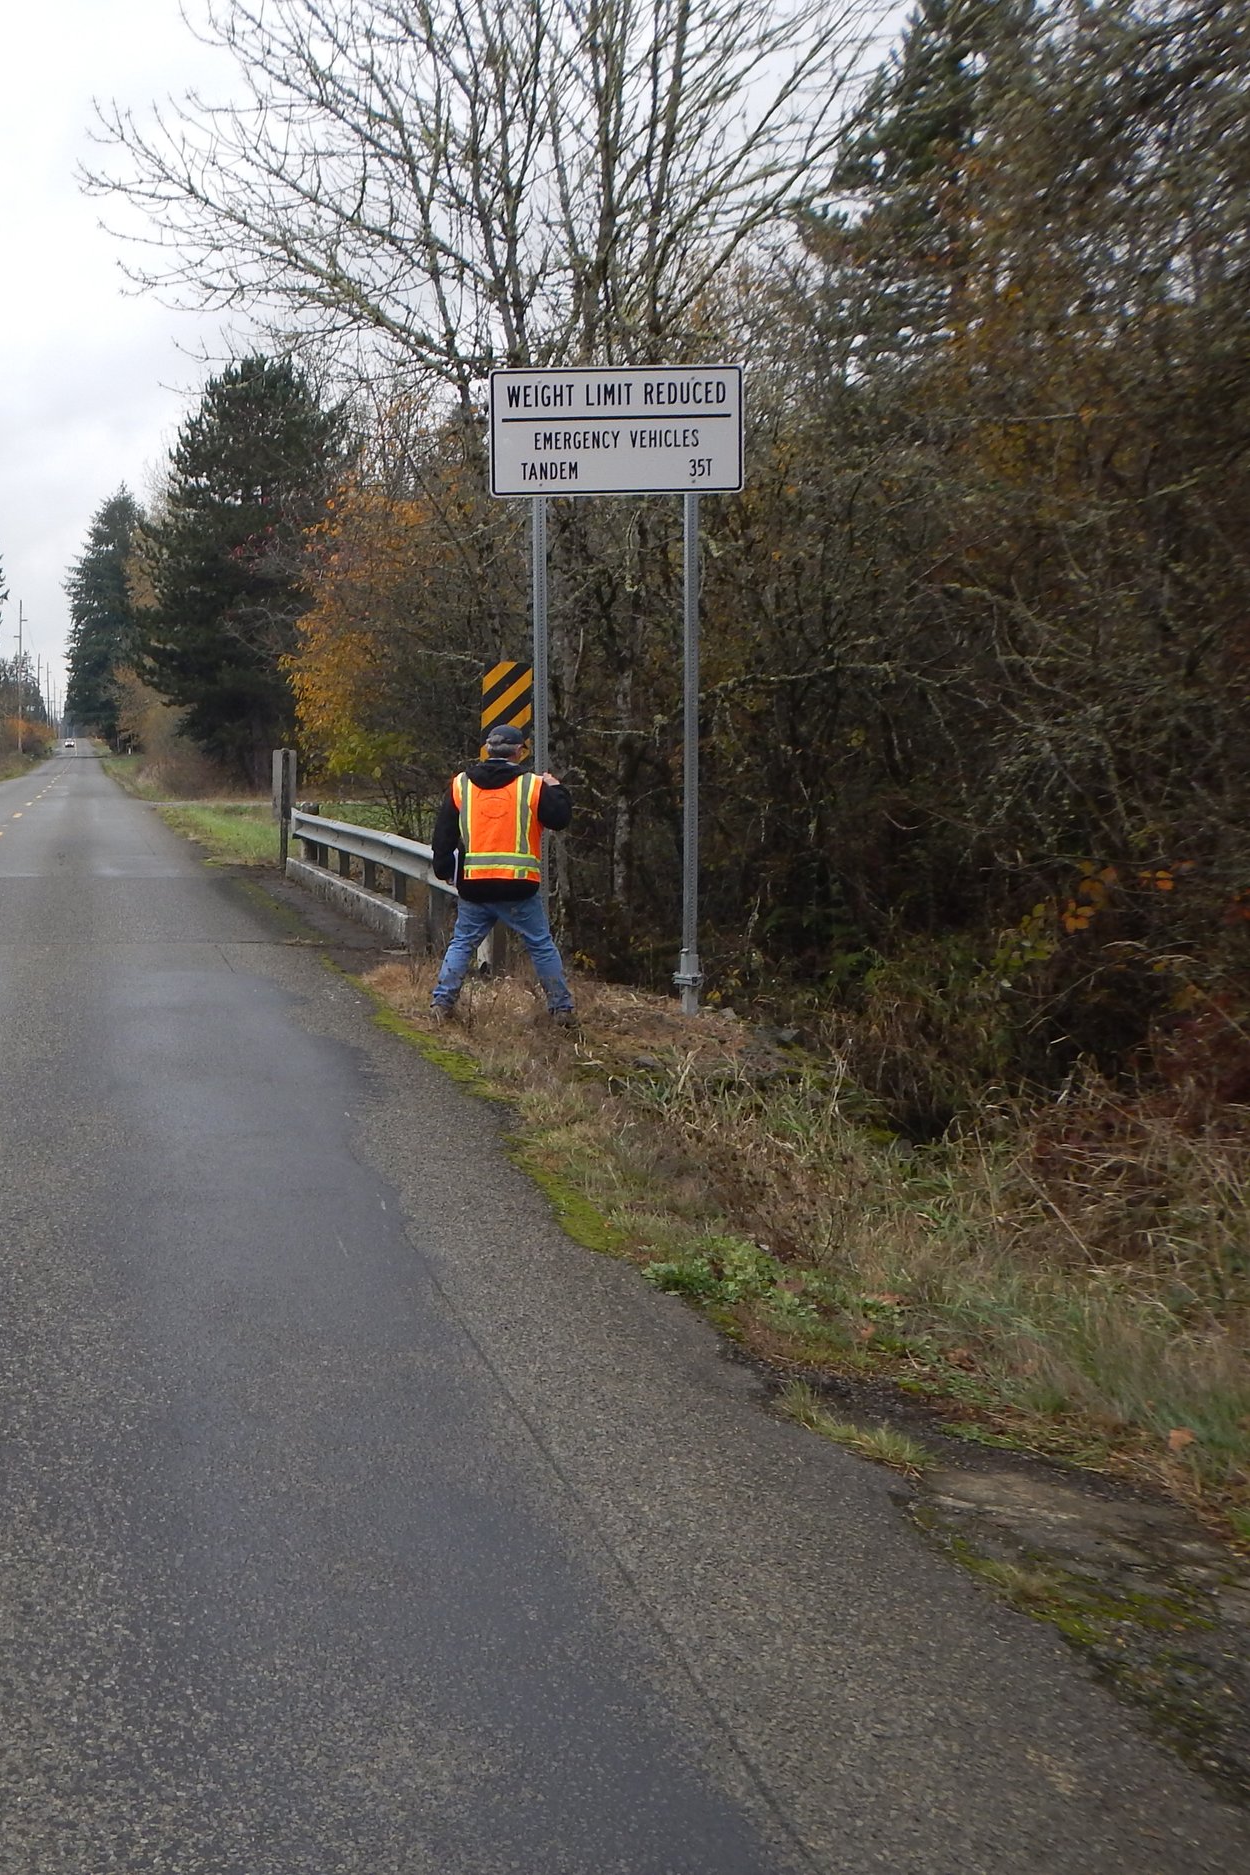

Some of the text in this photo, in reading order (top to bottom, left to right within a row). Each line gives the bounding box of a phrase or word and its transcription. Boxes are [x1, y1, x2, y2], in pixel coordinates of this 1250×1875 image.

[506, 381, 726, 408] WEIGHT LIMIT REDUCED
[534, 429, 700, 450] EMERGENCY VEHICLES
[521, 458, 713, 480] TANDEM 35T
